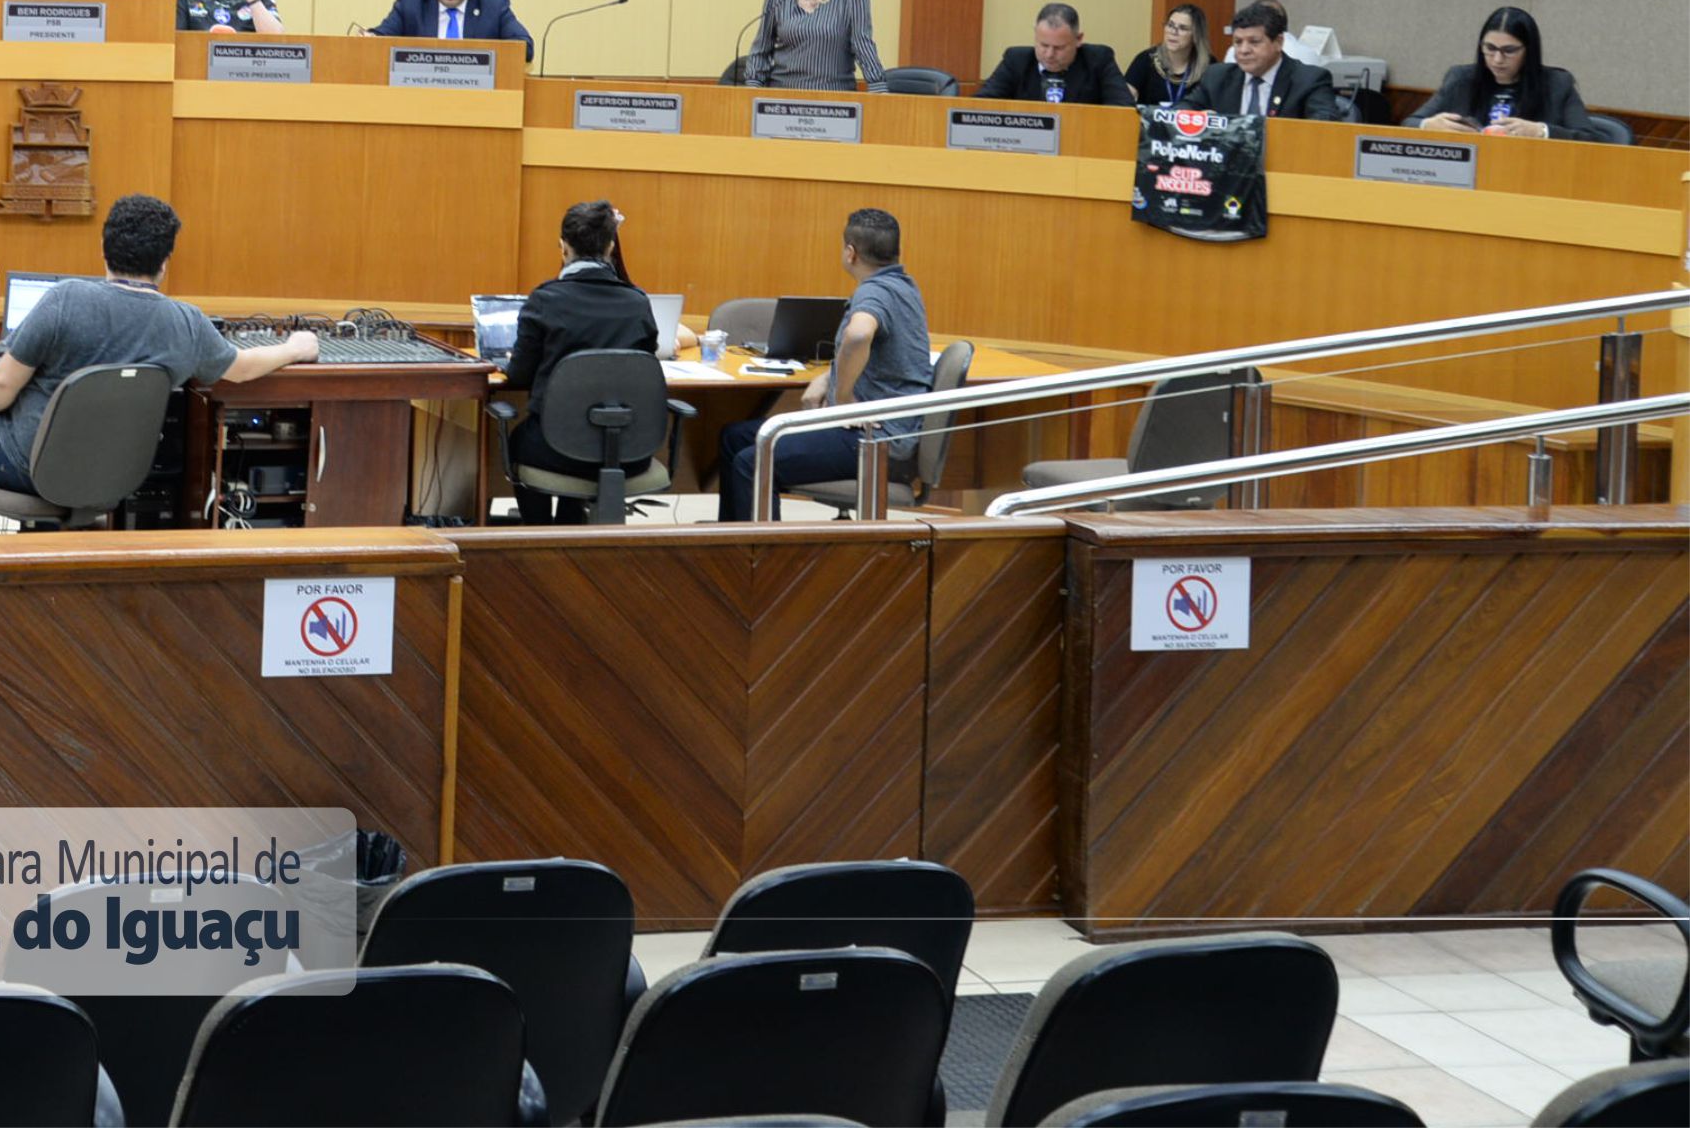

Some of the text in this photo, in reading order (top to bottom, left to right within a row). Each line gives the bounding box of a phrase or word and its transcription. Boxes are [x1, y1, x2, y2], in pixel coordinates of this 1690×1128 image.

[17, 7, 91, 17] BENI RODRIGUES
[29, 31, 76, 39] PRESIDENTE
[215, 47, 243, 56] NANCI
[255, 49, 304, 58] ANDREOLA
[405, 52, 479, 64] JOÃO MIRANDA
[583, 97, 675, 108] JEFERSON BRAYNER
[764, 104, 787, 114] INÊS
[961, 114, 1044, 127] MARINO GARCIA
[1153, 109, 1228, 130] NISSEI
[1151, 139, 1224, 163] PolpaNorte
[1370, 143, 1463, 159] ANICE GAZZAOUI
[1162, 563, 1223, 574] POR FAVOR
[296, 584, 364, 595] POR FAVOR
